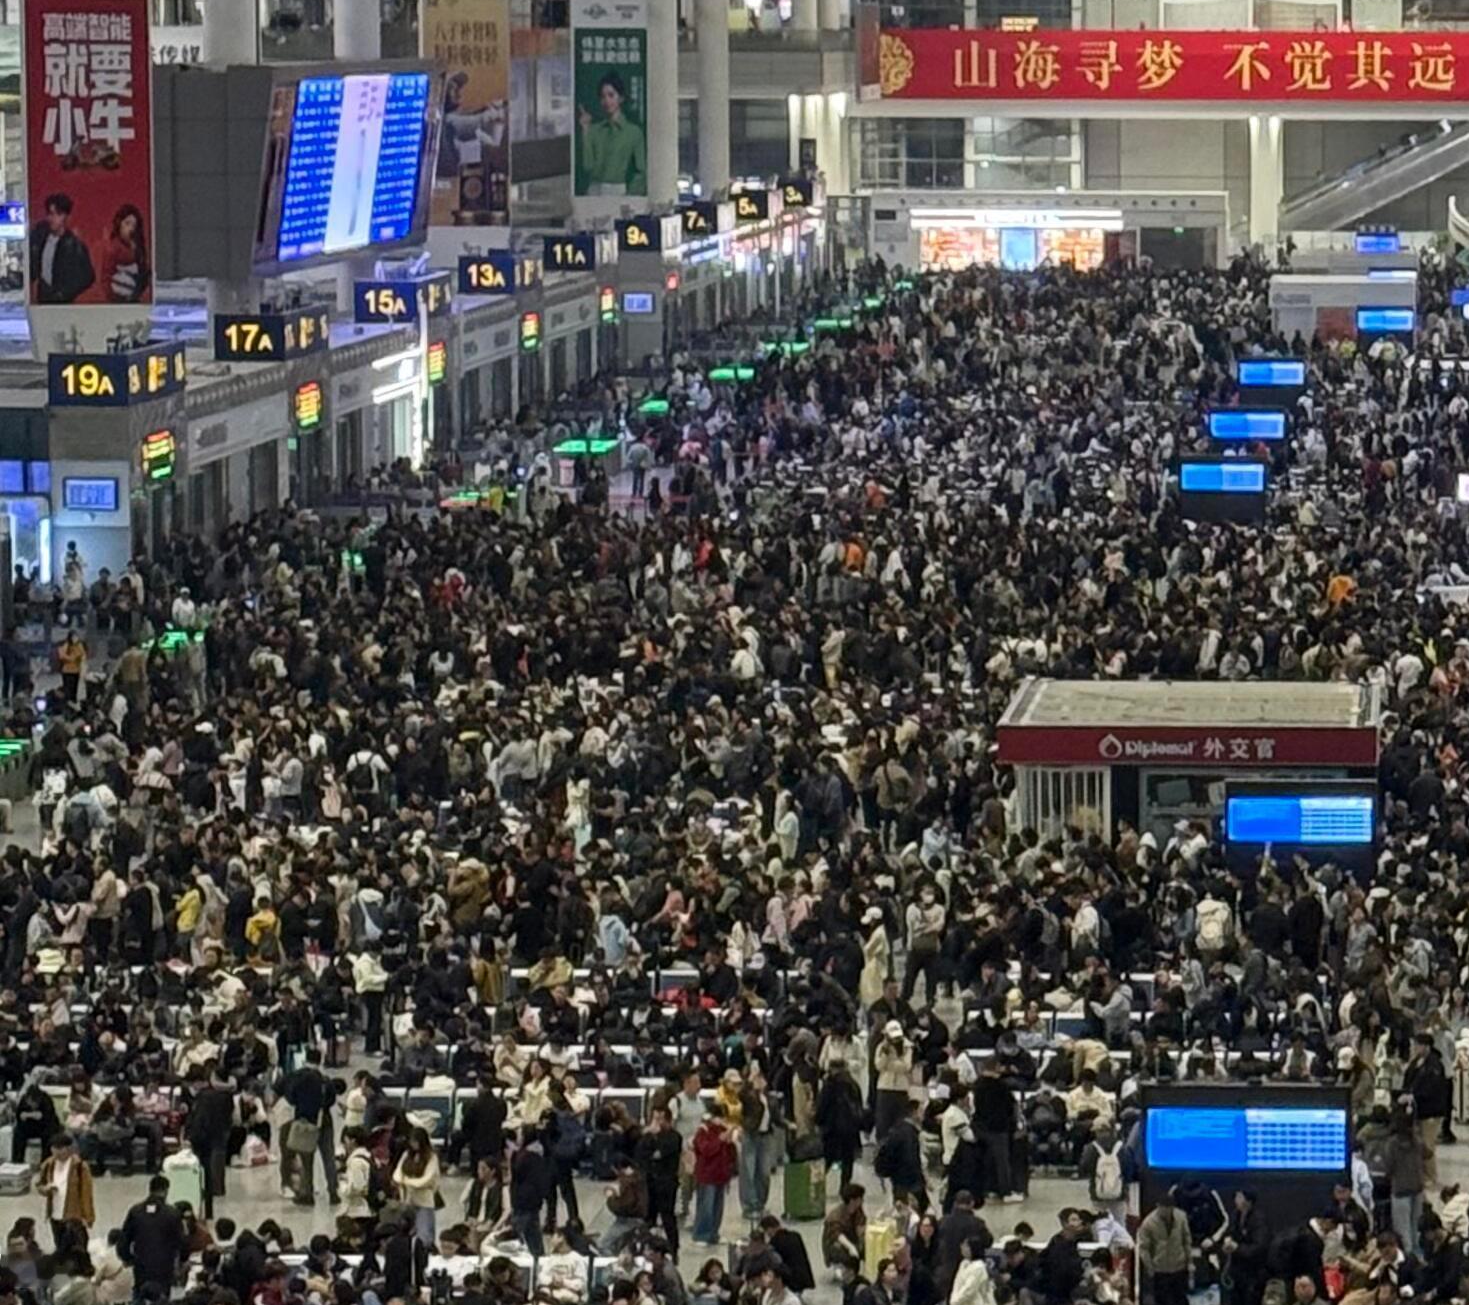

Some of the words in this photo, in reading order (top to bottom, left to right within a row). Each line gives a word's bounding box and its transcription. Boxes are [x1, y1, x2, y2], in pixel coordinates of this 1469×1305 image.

[43, 13, 132, 41] 高端智能
[44, 44, 133, 97] 就要
[953, 39, 1186, 91] 山海寻梦
[1224, 40, 1457, 92] 不觉其远
[43, 98, 135, 155] 小牛
[687, 210, 706, 228] 7A
[739, 197, 758, 216] 5A
[626, 225, 649, 246] 9A
[553, 244, 586, 264] 11A
[467, 263, 505, 287] 13A
[364, 289, 406, 315] 15A
[225, 324, 273, 352] 17A
[61, 364, 114, 396] 19A
[1203, 738, 1276, 759] 外交官
